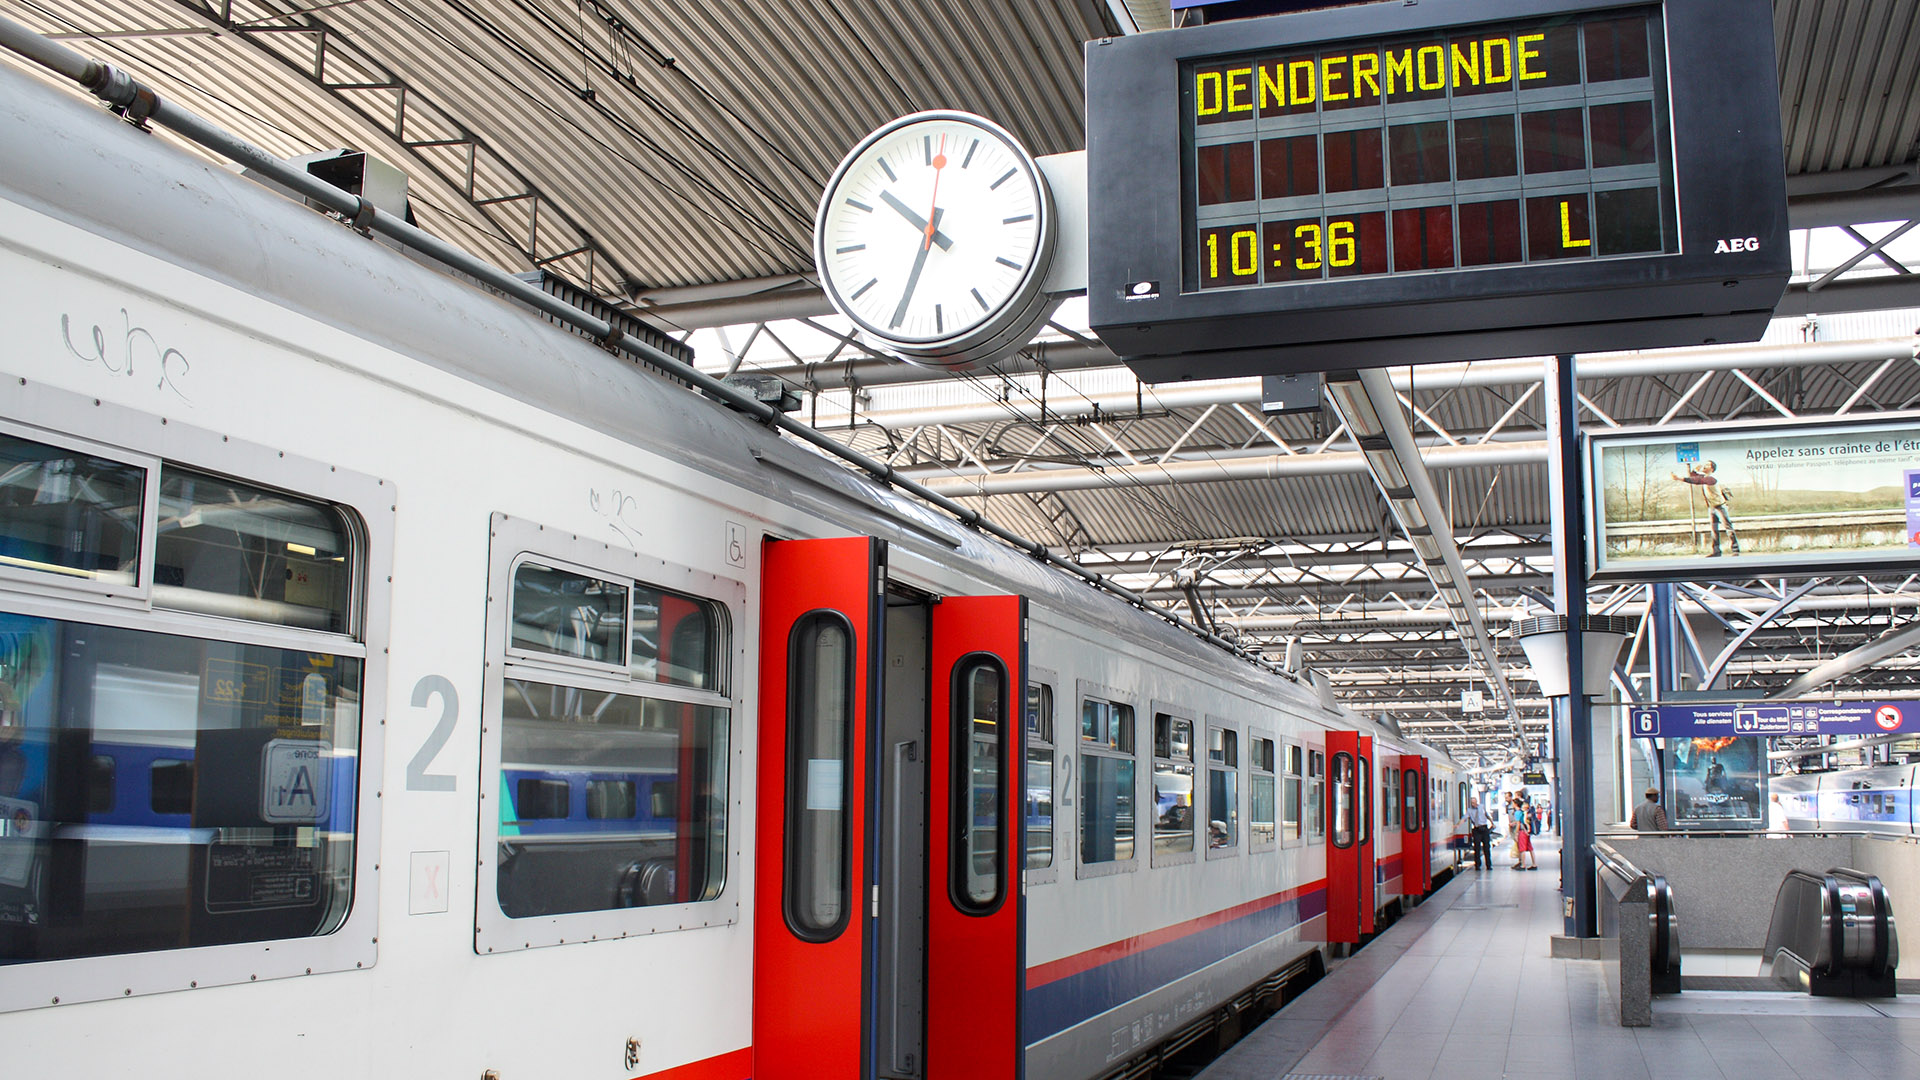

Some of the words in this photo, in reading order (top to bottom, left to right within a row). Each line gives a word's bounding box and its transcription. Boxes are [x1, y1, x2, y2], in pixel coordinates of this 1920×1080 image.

[1196, 33, 1547, 116] DENDERMONDE
[1206, 221, 1355, 278] 10:36
[1560, 202, 1591, 250] L
[1714, 237, 1760, 254] AEG
[1746, 447, 1794, 462] Appelez
[1798, 446, 1825, 457] sans
[1829, 443, 1871, 455] crainte
[1875, 441, 1890, 453] de
[406, 674, 459, 792] 2
[1640, 713, 1652, 732] 6
[1062, 754, 1072, 806] 2
